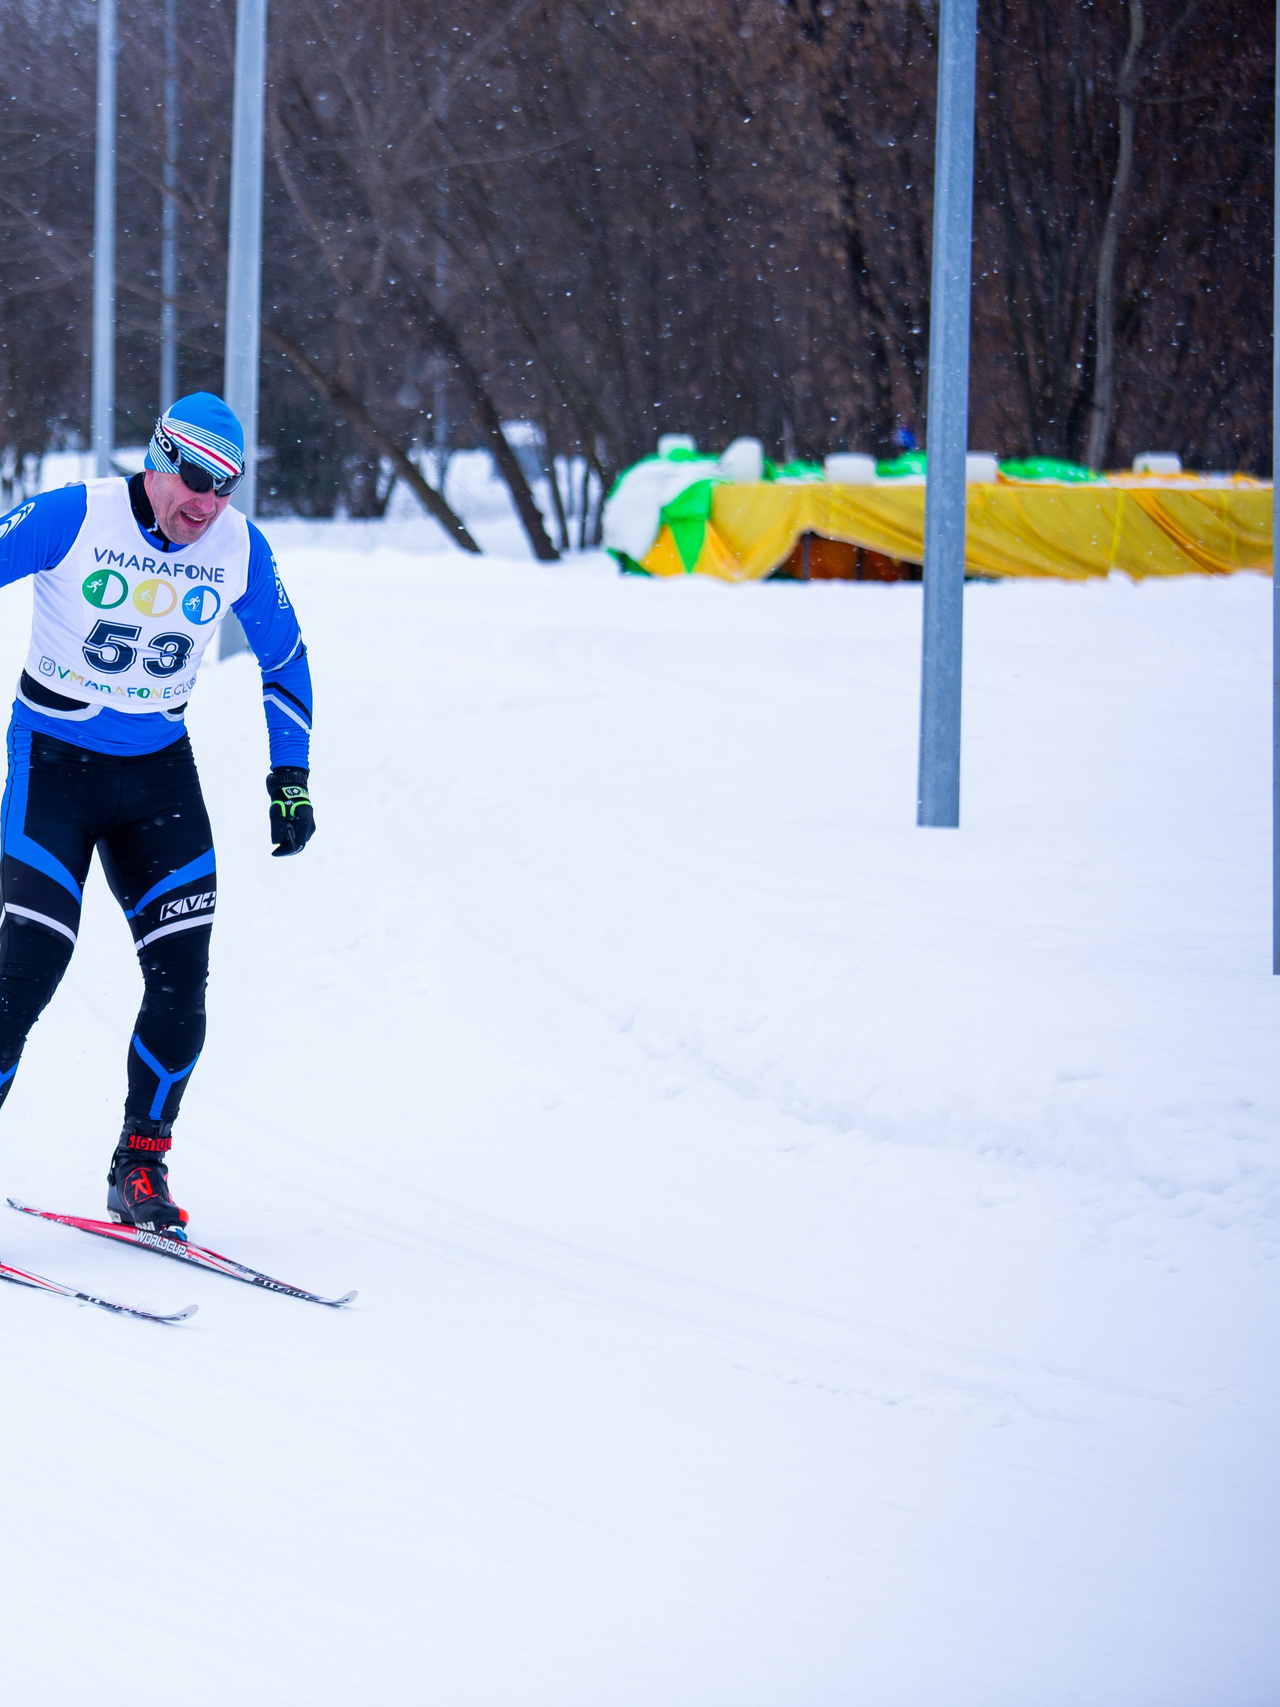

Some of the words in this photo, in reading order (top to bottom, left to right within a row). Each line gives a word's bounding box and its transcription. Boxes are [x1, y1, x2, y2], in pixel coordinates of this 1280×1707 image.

[93, 547, 225, 584] VMARAFONE
[82, 618, 195, 678] 53
[160, 891, 216, 921] KV+
[135, 1229, 187, 1256] WORLDCUP
